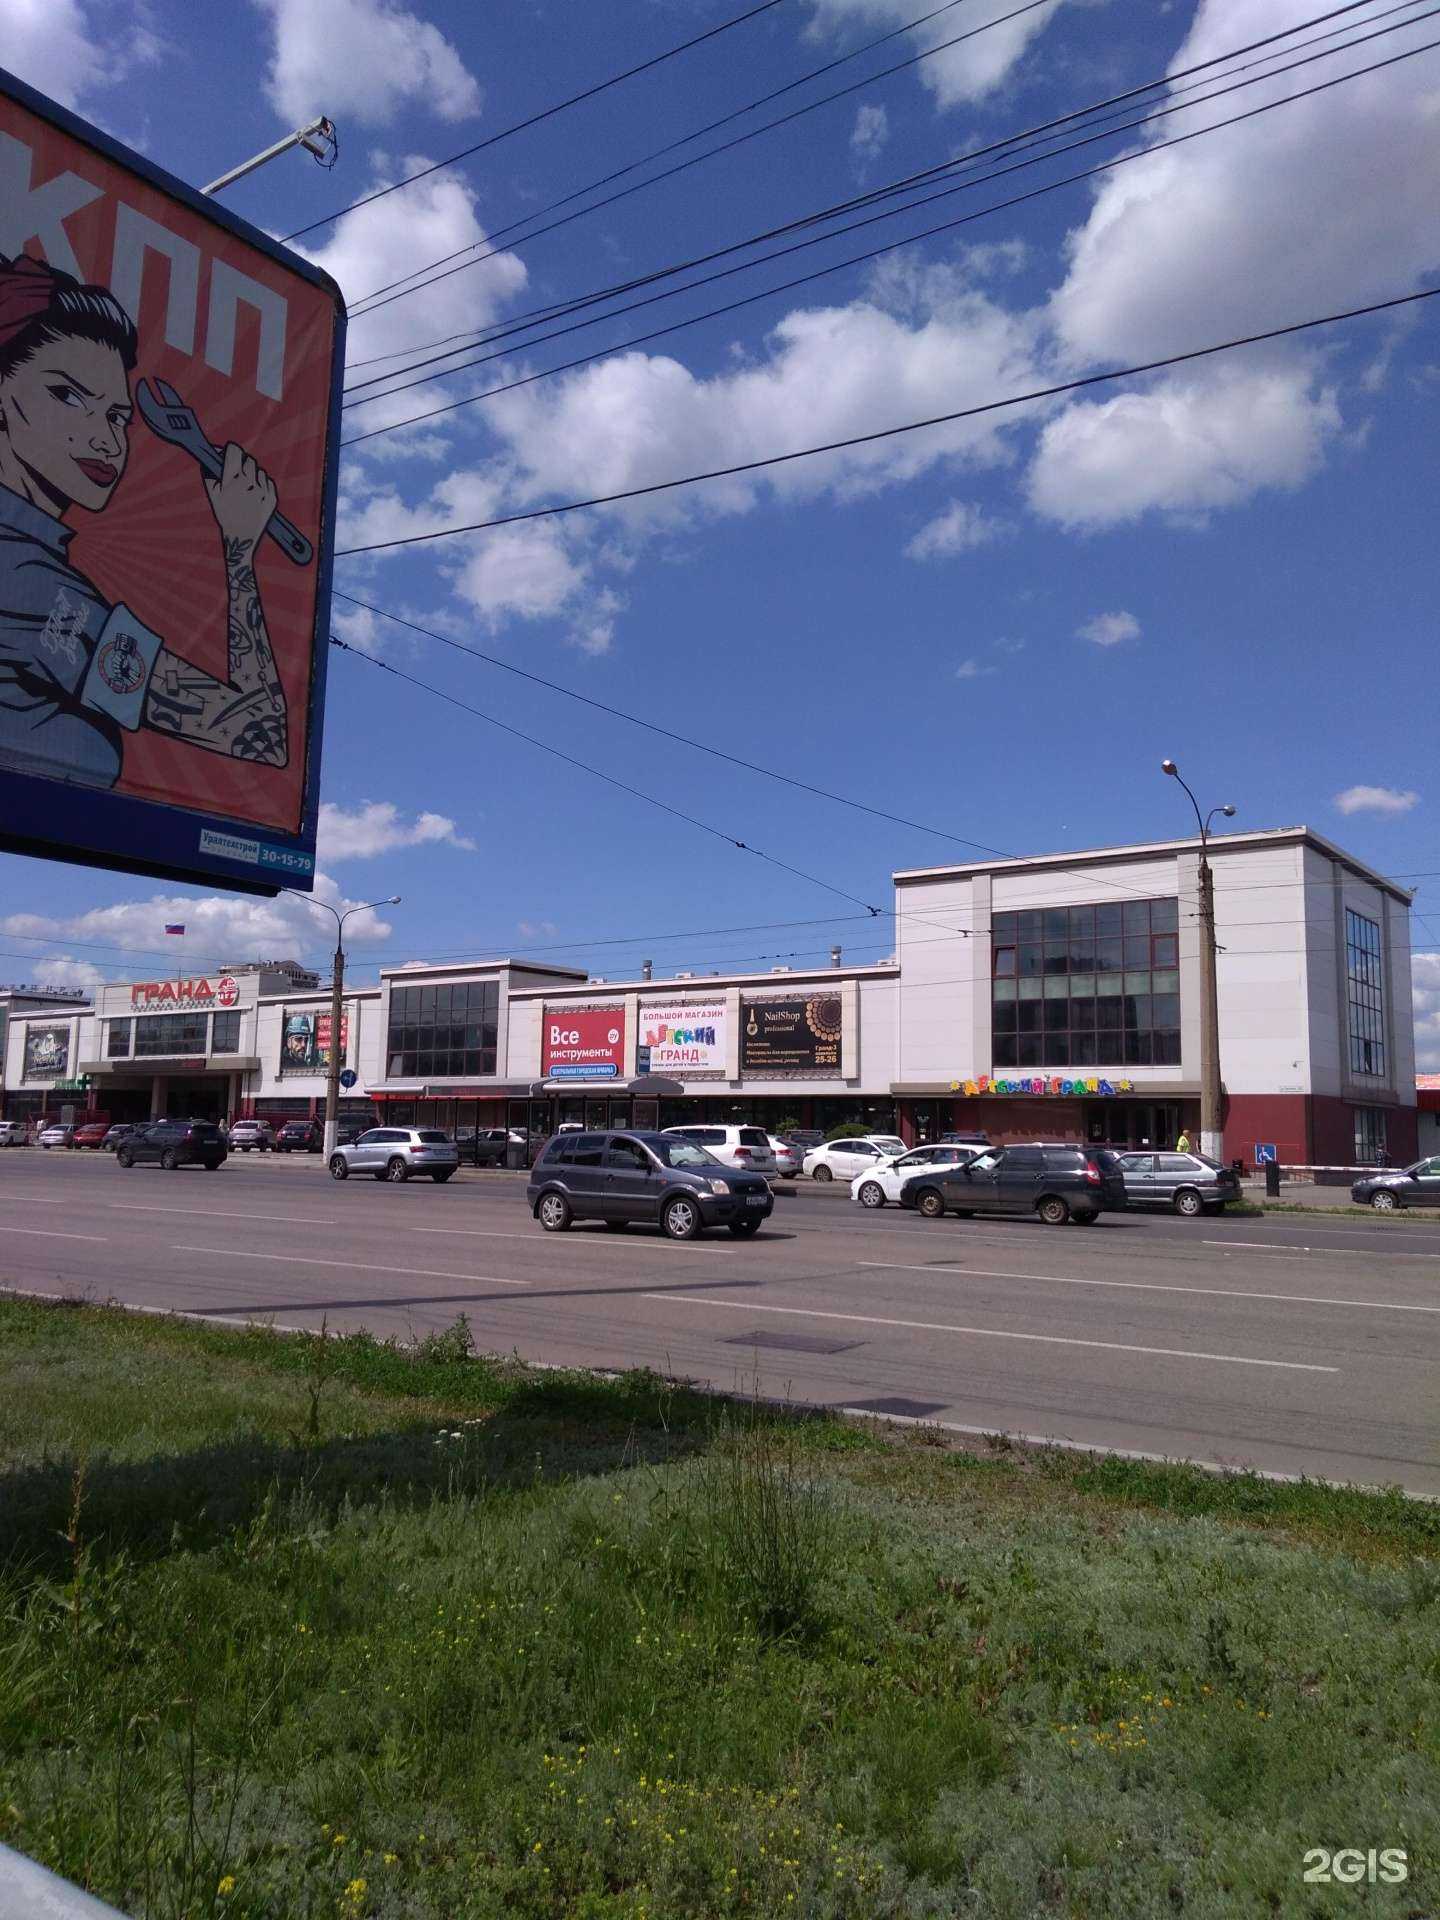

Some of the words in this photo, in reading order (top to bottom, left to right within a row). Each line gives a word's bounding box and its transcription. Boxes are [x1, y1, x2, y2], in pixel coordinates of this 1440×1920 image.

[203, 832, 257, 853] Уралтехстрой
[262, 848, 311, 869] 30-15-79
[131, 976, 216, 1004] ГРАНД
[684, 1010, 723, 1018] МАГАЗИН
[765, 1012, 800, 1022] NailShop
[550, 1025, 580, 1046] Все
[550, 1048, 612, 1061] инструменты
[660, 1049, 699, 1062] ГРАНД
[964, 1074, 1045, 1096] ДЕТСКИЙ
[1050, 1076, 1115, 1095] ГРАНД
